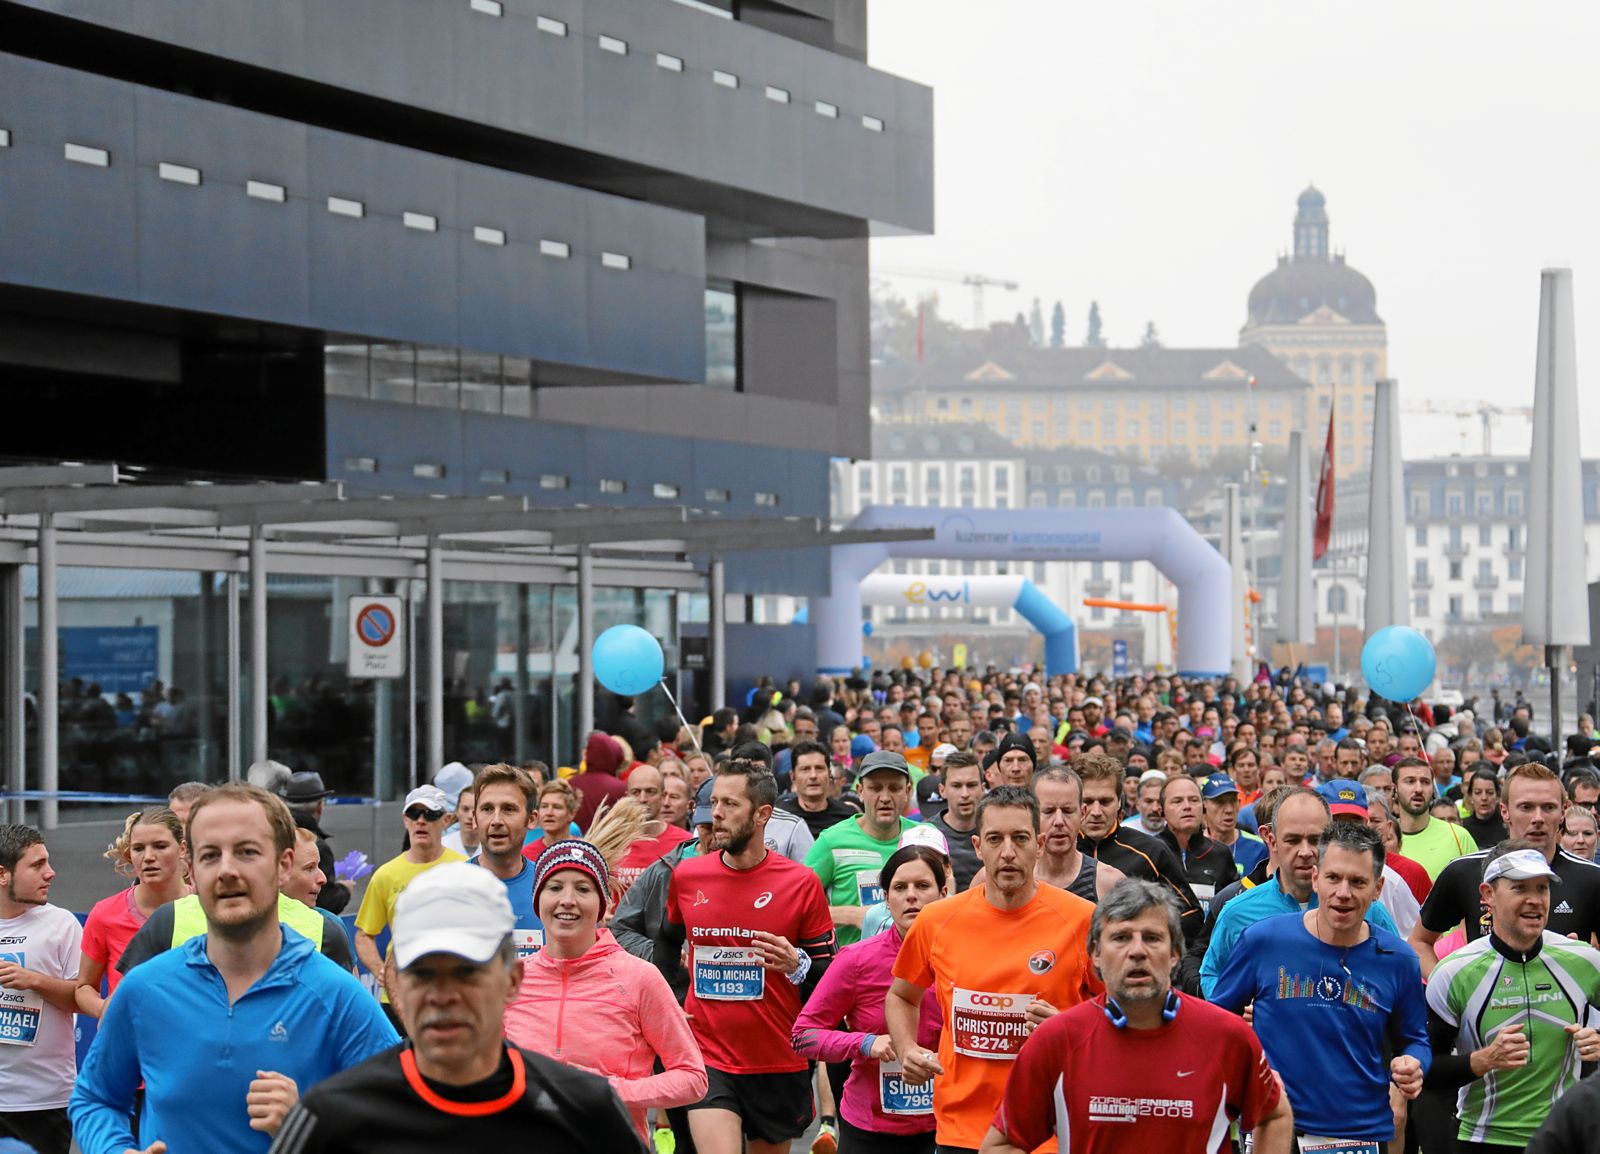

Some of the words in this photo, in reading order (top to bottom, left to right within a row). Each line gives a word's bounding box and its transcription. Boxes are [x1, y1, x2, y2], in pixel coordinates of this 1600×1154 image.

[698, 968, 721, 980] FABIO
[723, 969, 760, 981] MICHAEL
[713, 982, 744, 993] 1193
[970, 994, 1013, 1009] coop
[970, 1035, 1009, 1050] 3274
[1088, 1103, 1137, 1115] MARATHON
[1140, 1106, 1193, 1118] 2009
[1140, 1099, 1193, 1108] FINISHER
